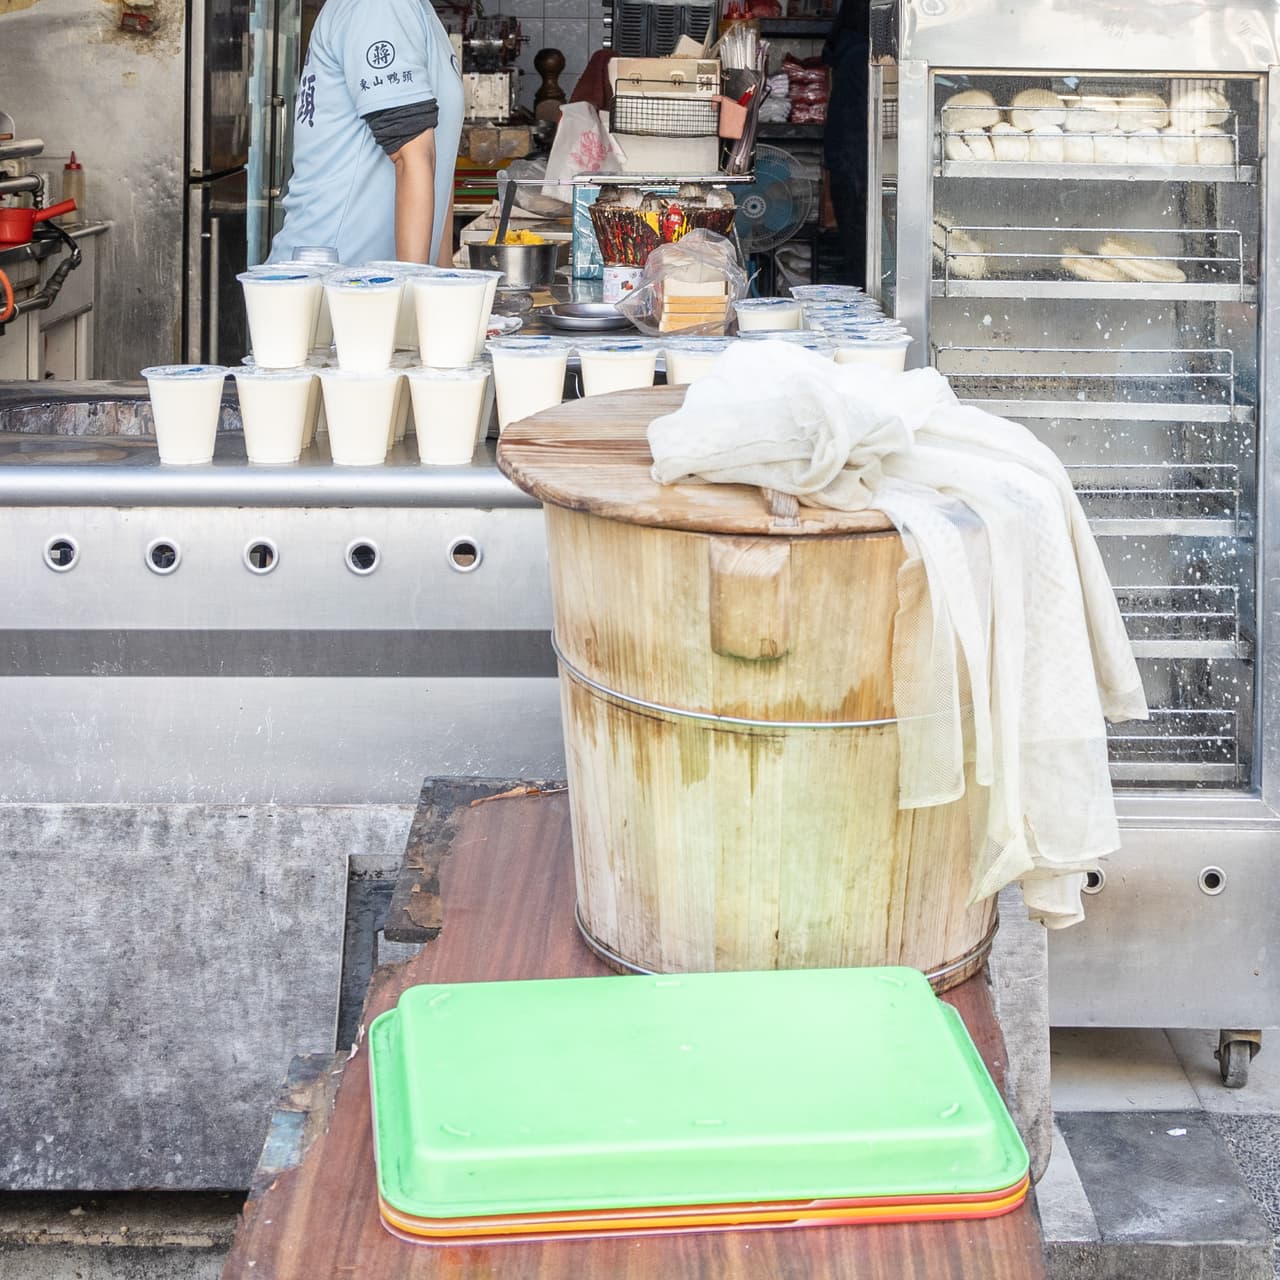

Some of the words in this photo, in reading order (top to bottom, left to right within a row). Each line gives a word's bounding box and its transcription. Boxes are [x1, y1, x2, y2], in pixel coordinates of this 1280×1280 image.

[372, 43, 391, 65] 蔣
[359, 70, 414, 92] 東山鴨頭
